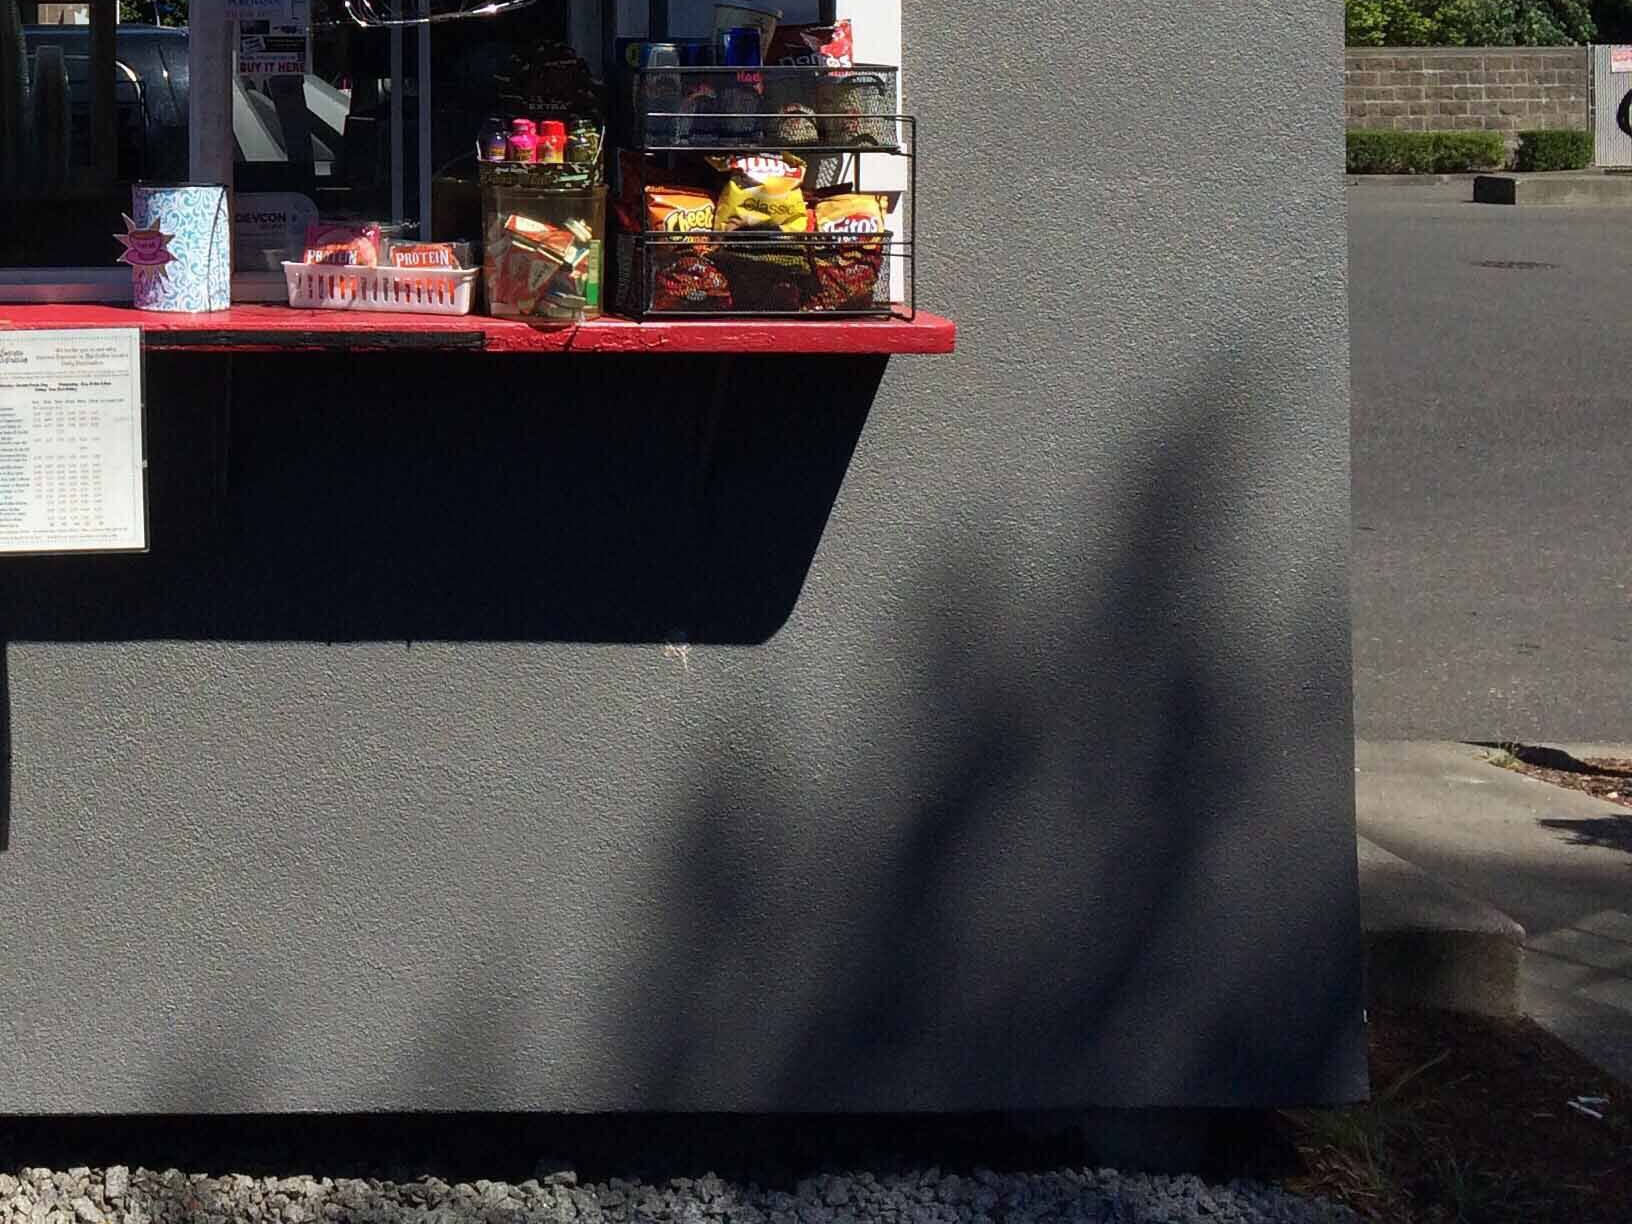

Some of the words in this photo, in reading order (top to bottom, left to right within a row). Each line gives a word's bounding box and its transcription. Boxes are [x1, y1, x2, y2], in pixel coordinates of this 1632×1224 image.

[743, 197, 796, 216] Classic
[665, 206, 714, 233] Cheet
[306, 248, 358, 266] PROTEIN
[395, 250, 450, 267] PROTEIN
